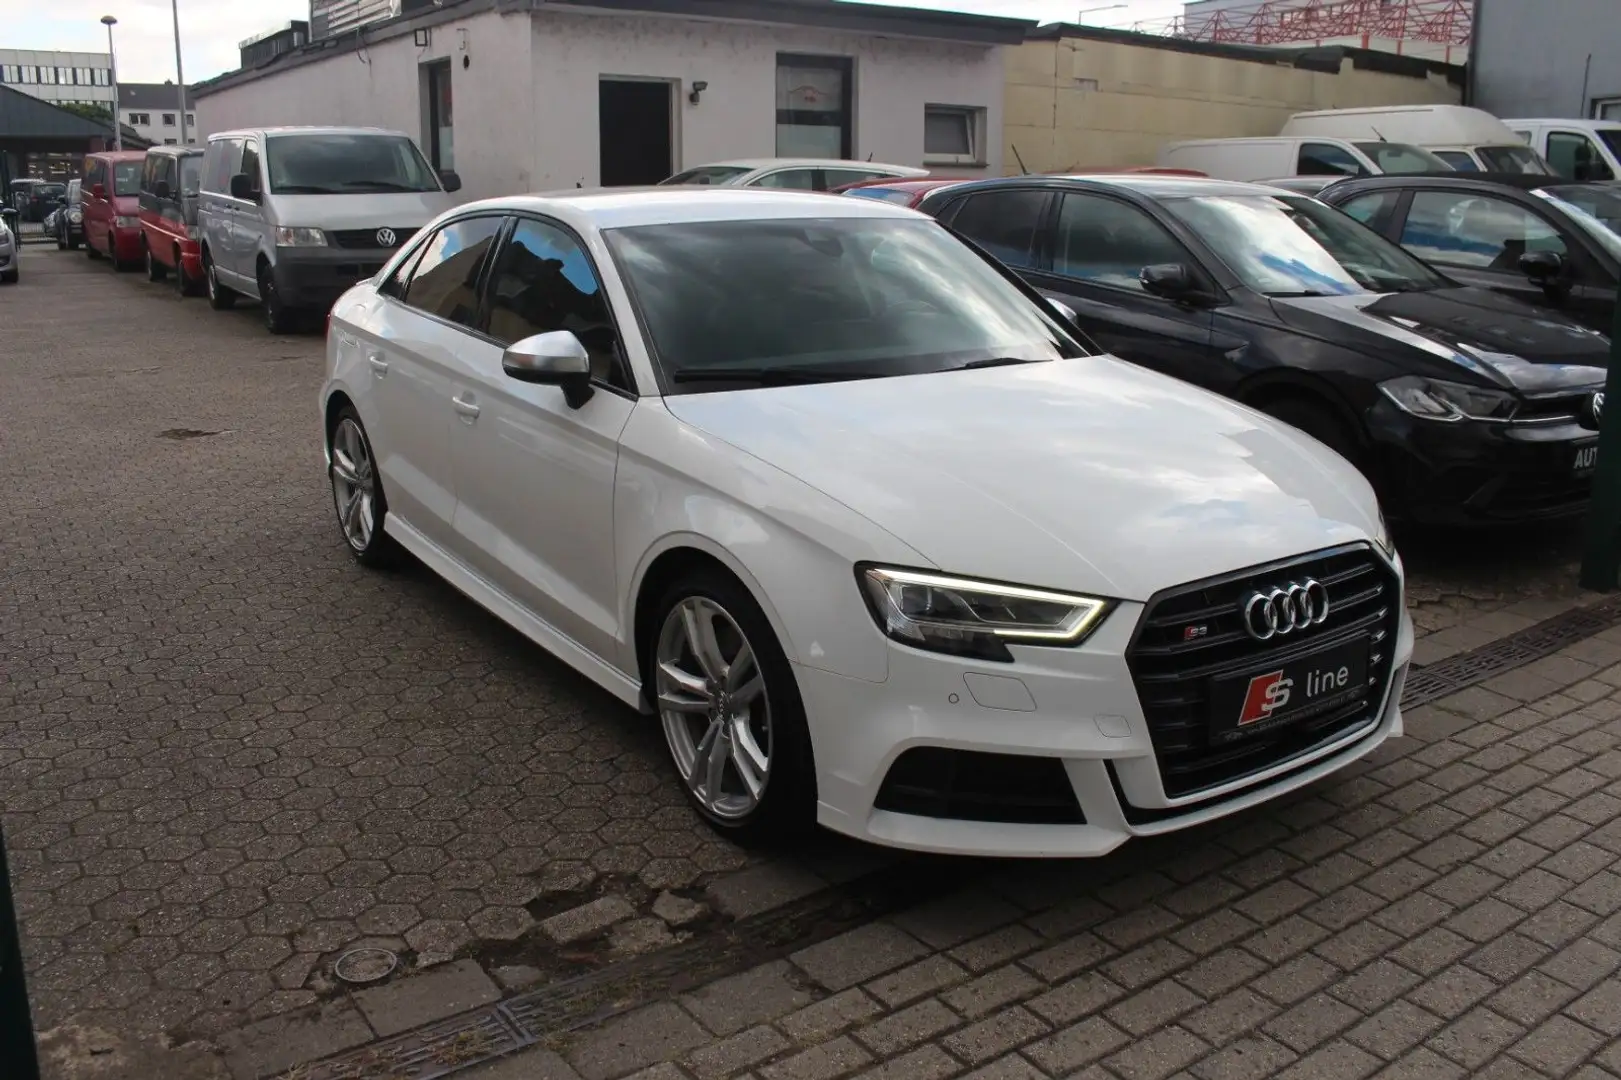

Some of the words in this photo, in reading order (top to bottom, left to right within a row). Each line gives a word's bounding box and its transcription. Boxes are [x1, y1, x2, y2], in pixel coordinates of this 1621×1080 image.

[376, 228, 396, 248] VW
[1261, 676, 1294, 711] S
[1306, 666, 1349, 697] line
